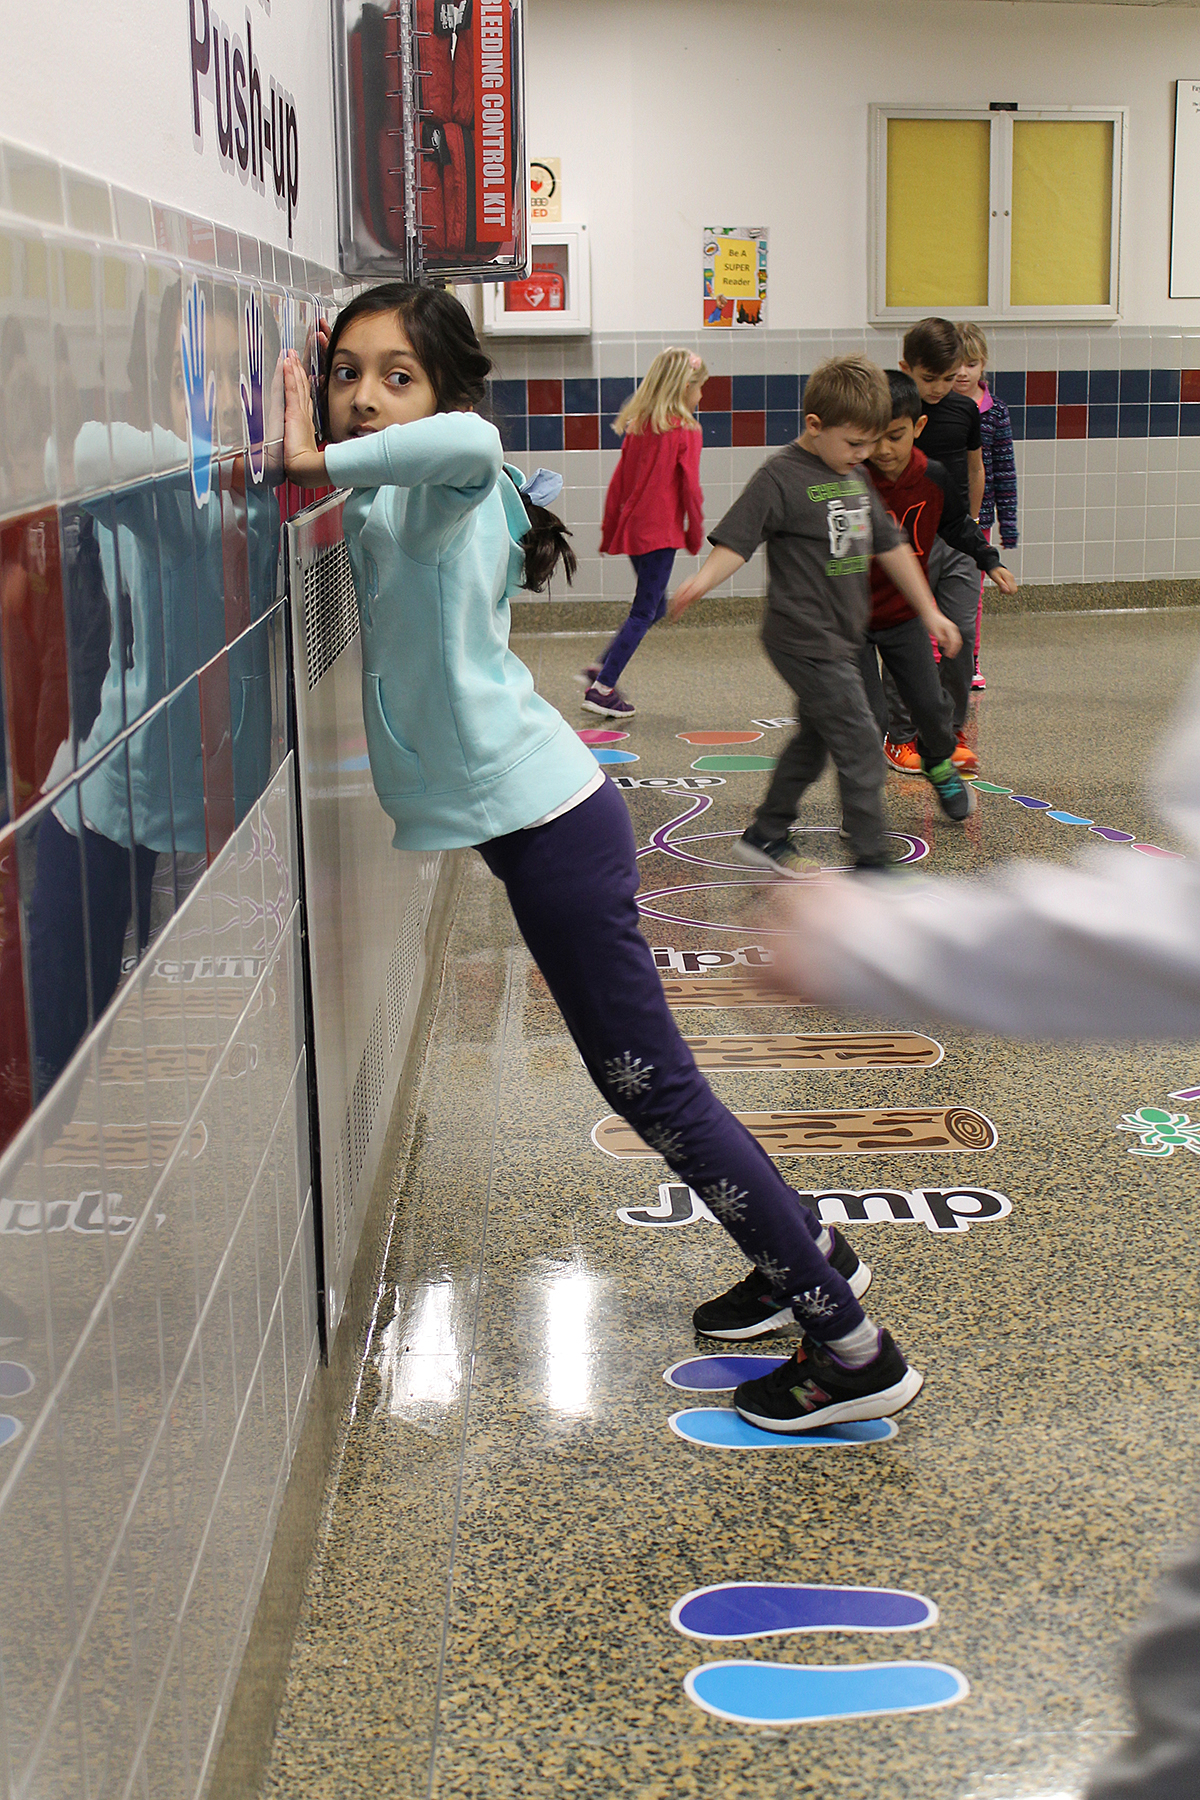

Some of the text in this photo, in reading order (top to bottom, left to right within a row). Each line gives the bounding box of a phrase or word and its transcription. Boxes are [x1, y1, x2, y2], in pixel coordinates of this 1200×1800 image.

[188, 0, 299, 239] Push-up
[481, 94, 506, 188] CONTROL
[483, 193, 506, 227] KIT
[531, 208, 549, 218] ED
[728, 249, 747, 257] Be A
[724, 263, 751, 272] SUPER
[722, 277, 751, 286] Reader
[626, 1186, 1003, 1229] Jmp
